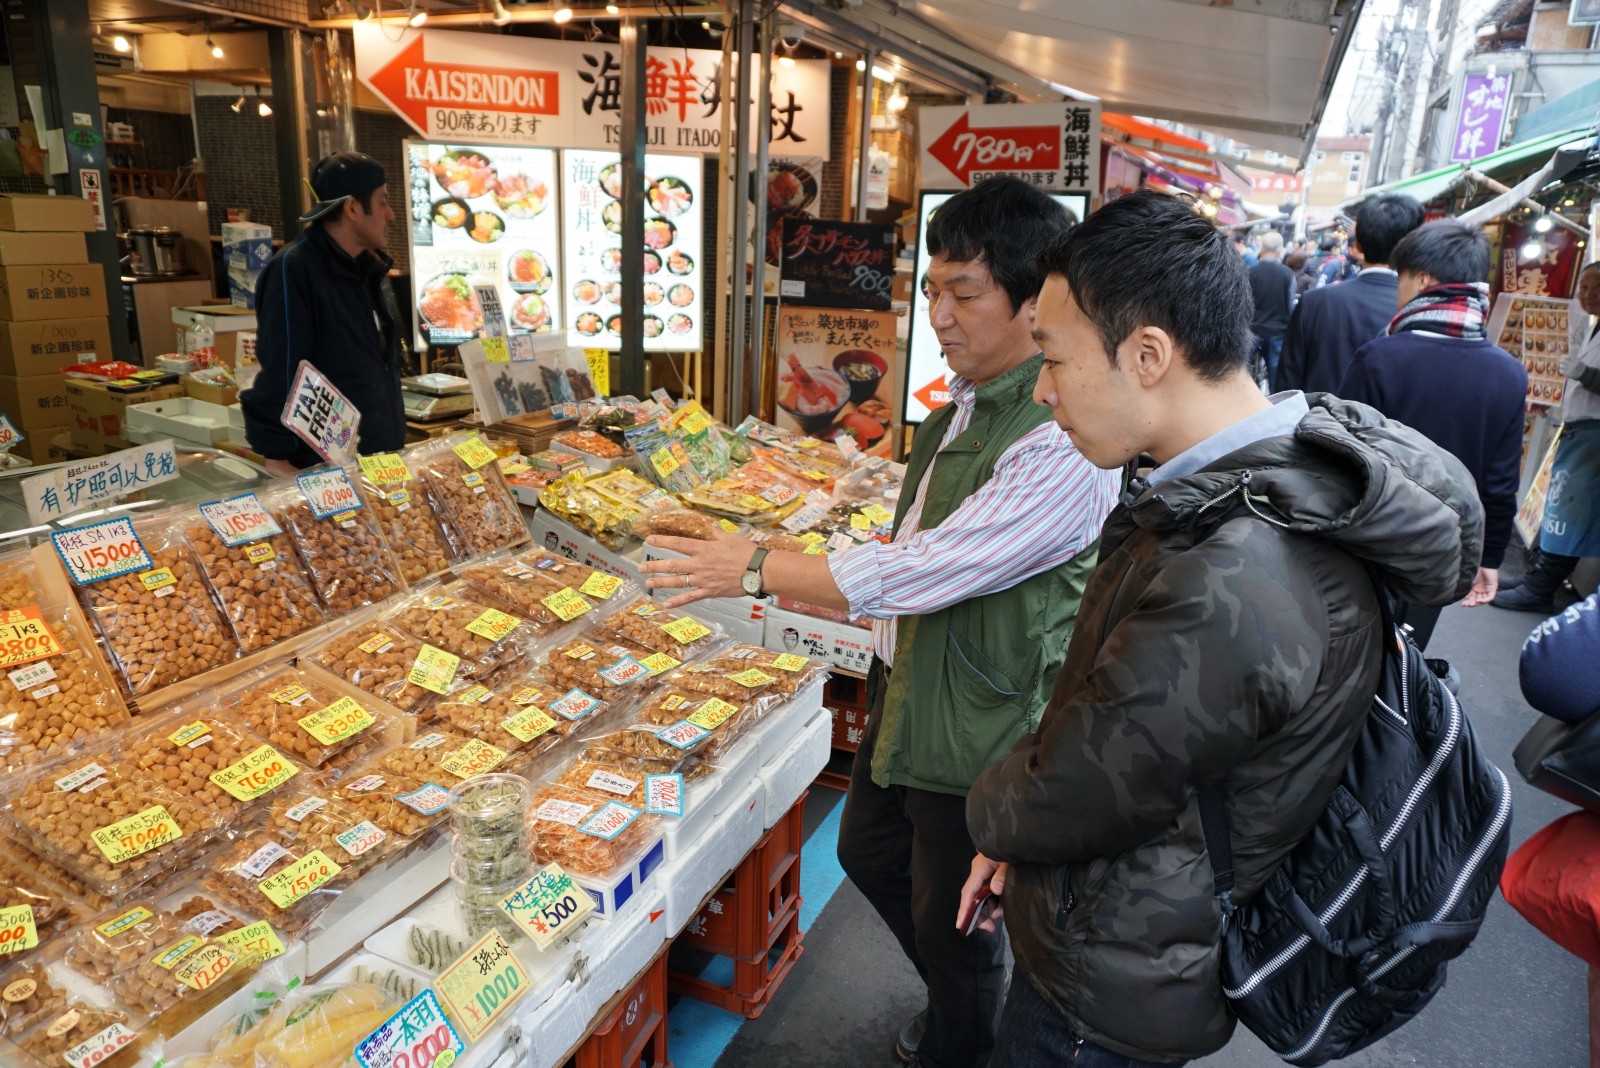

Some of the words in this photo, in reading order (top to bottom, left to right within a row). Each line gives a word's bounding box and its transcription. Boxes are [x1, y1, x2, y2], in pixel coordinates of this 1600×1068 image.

[404, 68, 545, 108] KAISENDON
[436, 109, 542, 135] 90席あります
[603, 124, 665, 145] TSIJI
[676, 128, 735, 148] ITADOI
[1064, 106, 1091, 187] 海鮮丼
[848, 265, 893, 290] 980
[26, 286, 92, 300] 新企画珍味
[478, 288, 498, 303] TAX
[482, 302, 502, 317] FREE
[817, 314, 880, 331] 築地市場の
[30, 340, 97, 355] 新企画珍味
[825, 331, 894, 349] まんぞくセット
[292, 374, 321, 424] TAX
[308, 386, 336, 442] FREE
[40, 451, 177, 513] 有护照可以免税
[374, 467, 407, 481] 21000
[324, 709, 364, 736] 8300
[520, 716, 548, 735] 5400
[251, 747, 277, 767] 500g
[461, 748, 495, 776] 3600
[237, 761, 283, 790] 7600
[95, 826, 130, 847] 貝柱
[140, 809, 171, 828] 500g
[120, 822, 169, 851] 7000
[263, 873, 292, 891] 貝柱
[290, 865, 329, 897] 1500
[504, 870, 556, 916] 大サービス品
[528, 895, 578, 934] ¥500
[241, 924, 269, 942] 100g
[194, 955, 231, 989] 1200
[463, 965, 520, 1022] ¥1000
[360, 1022, 393, 1061] 最高品
[392, 1024, 451, 1068] 2000
